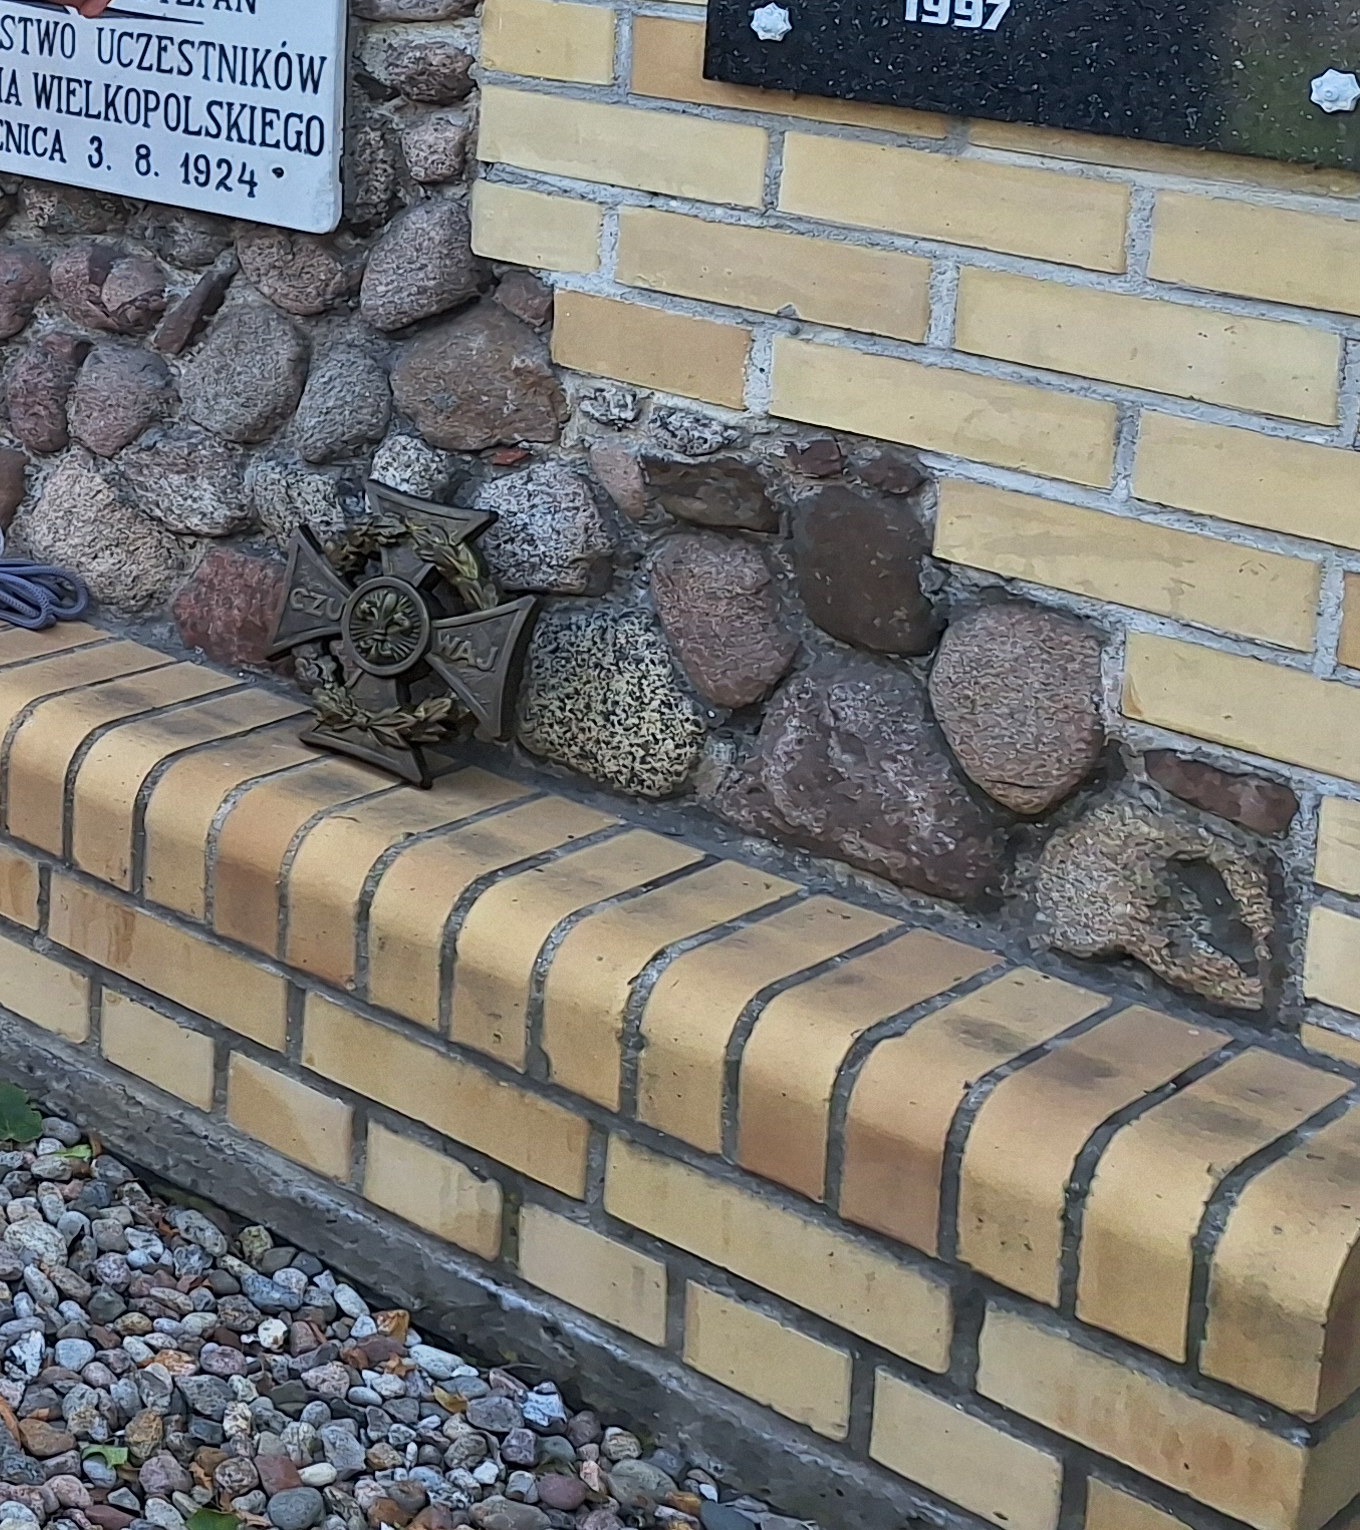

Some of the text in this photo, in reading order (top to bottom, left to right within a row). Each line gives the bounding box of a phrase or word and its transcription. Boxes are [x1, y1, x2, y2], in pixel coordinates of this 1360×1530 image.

[96, 26, 327, 97] UCZESTNIKÓW
[34, 71, 326, 157] WIELKOPOLSKIEGO
[88, 135, 111, 172] 3.
[135, 144, 159, 178] 8.
[180, 151, 259, 198] 1924
[437, 629, 499, 672] WAJ
